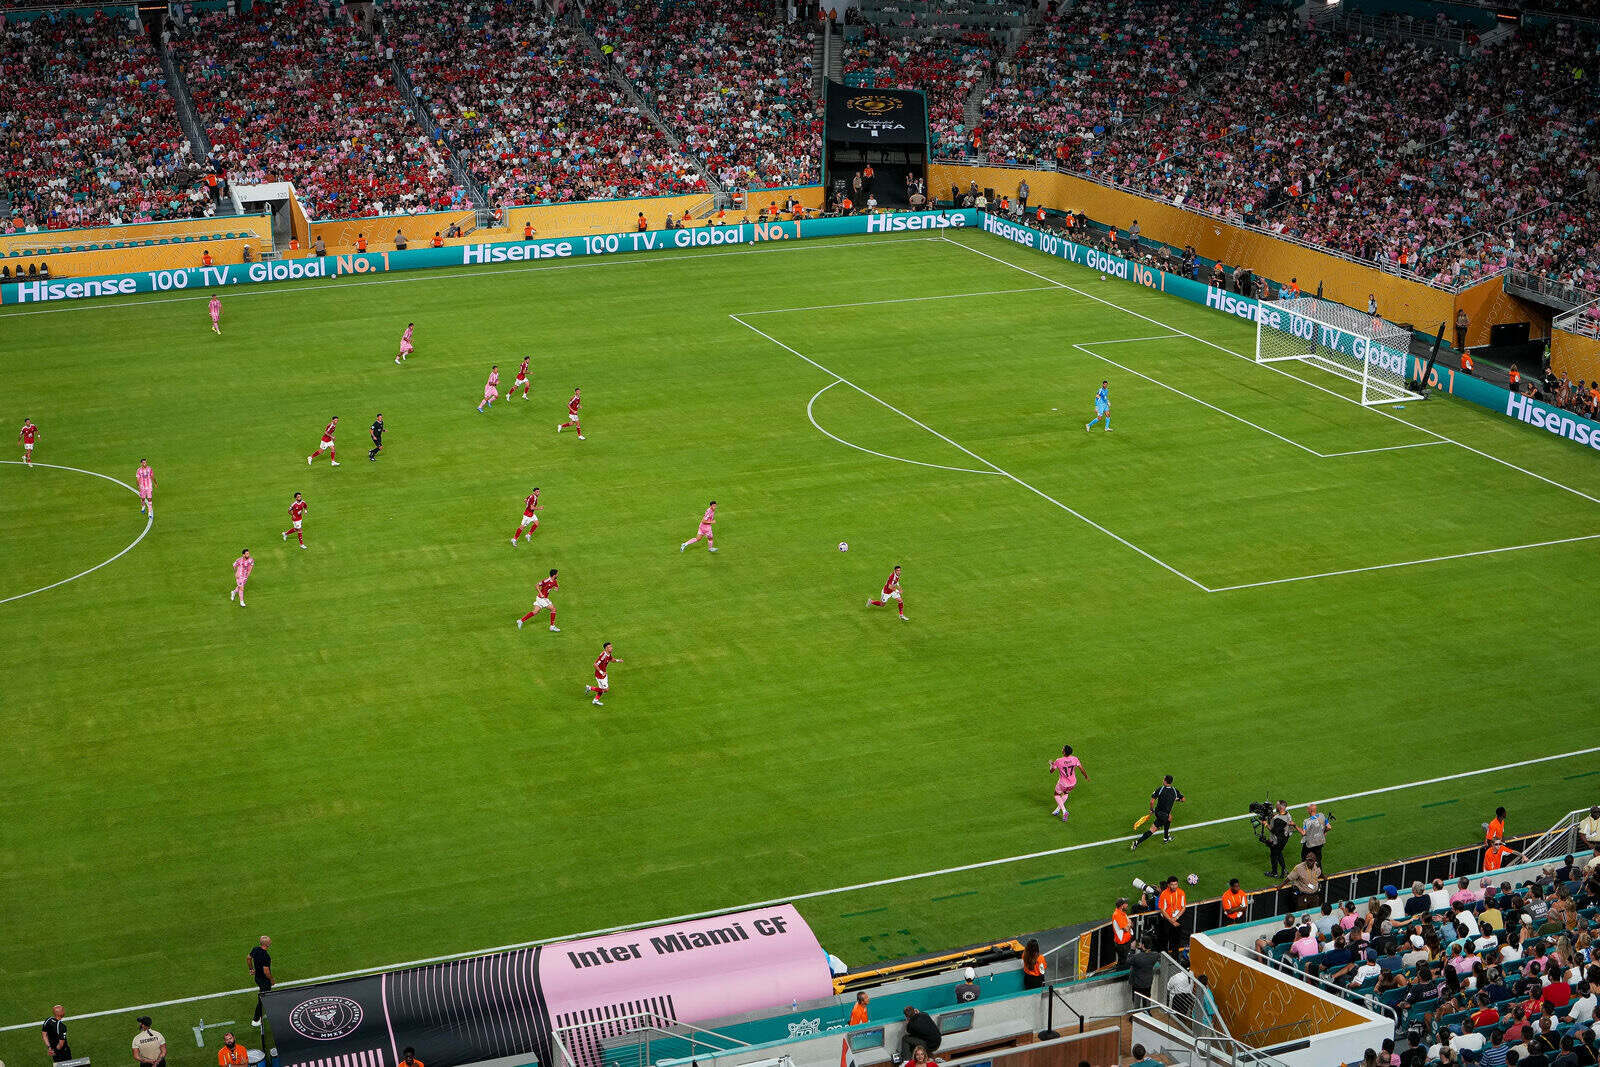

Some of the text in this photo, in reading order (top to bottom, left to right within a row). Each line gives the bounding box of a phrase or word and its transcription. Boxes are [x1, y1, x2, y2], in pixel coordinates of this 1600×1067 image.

[846, 122, 906, 130] ULTRA
[461, 240, 572, 265] Hisense
[629, 231, 664, 251] TV,
[674, 224, 744, 248] Global
[753, 223, 791, 242] No.
[793, 220, 802, 238] 1
[866, 212, 966, 233] Hisense
[983, 212, 1034, 248] Hisense
[1063, 239, 1081, 263] TV,
[1086, 249, 1128, 280] Global
[1133, 262, 1157, 289] No.
[1160, 271, 1166, 292] 1
[18, 278, 137, 303] Hisense
[199, 265, 238, 286] TV,
[249, 251, 326, 280] Global
[336, 255, 377, 275] No.
[380, 252, 390, 271] 1
[1206, 285, 1281, 329] Hisense
[1353, 337, 1407, 379] Gobal
[1413, 356, 1443, 391] No.
[1448, 368, 1455, 394] 1
[1505, 389, 1600, 451] Hisense
[1062, 765, 1075, 777] 17
[567, 916, 788, 969] Inter Miami CF
[310, 1004, 337, 1013] MIAMI
[139, 1036, 159, 1044] SECURITY
